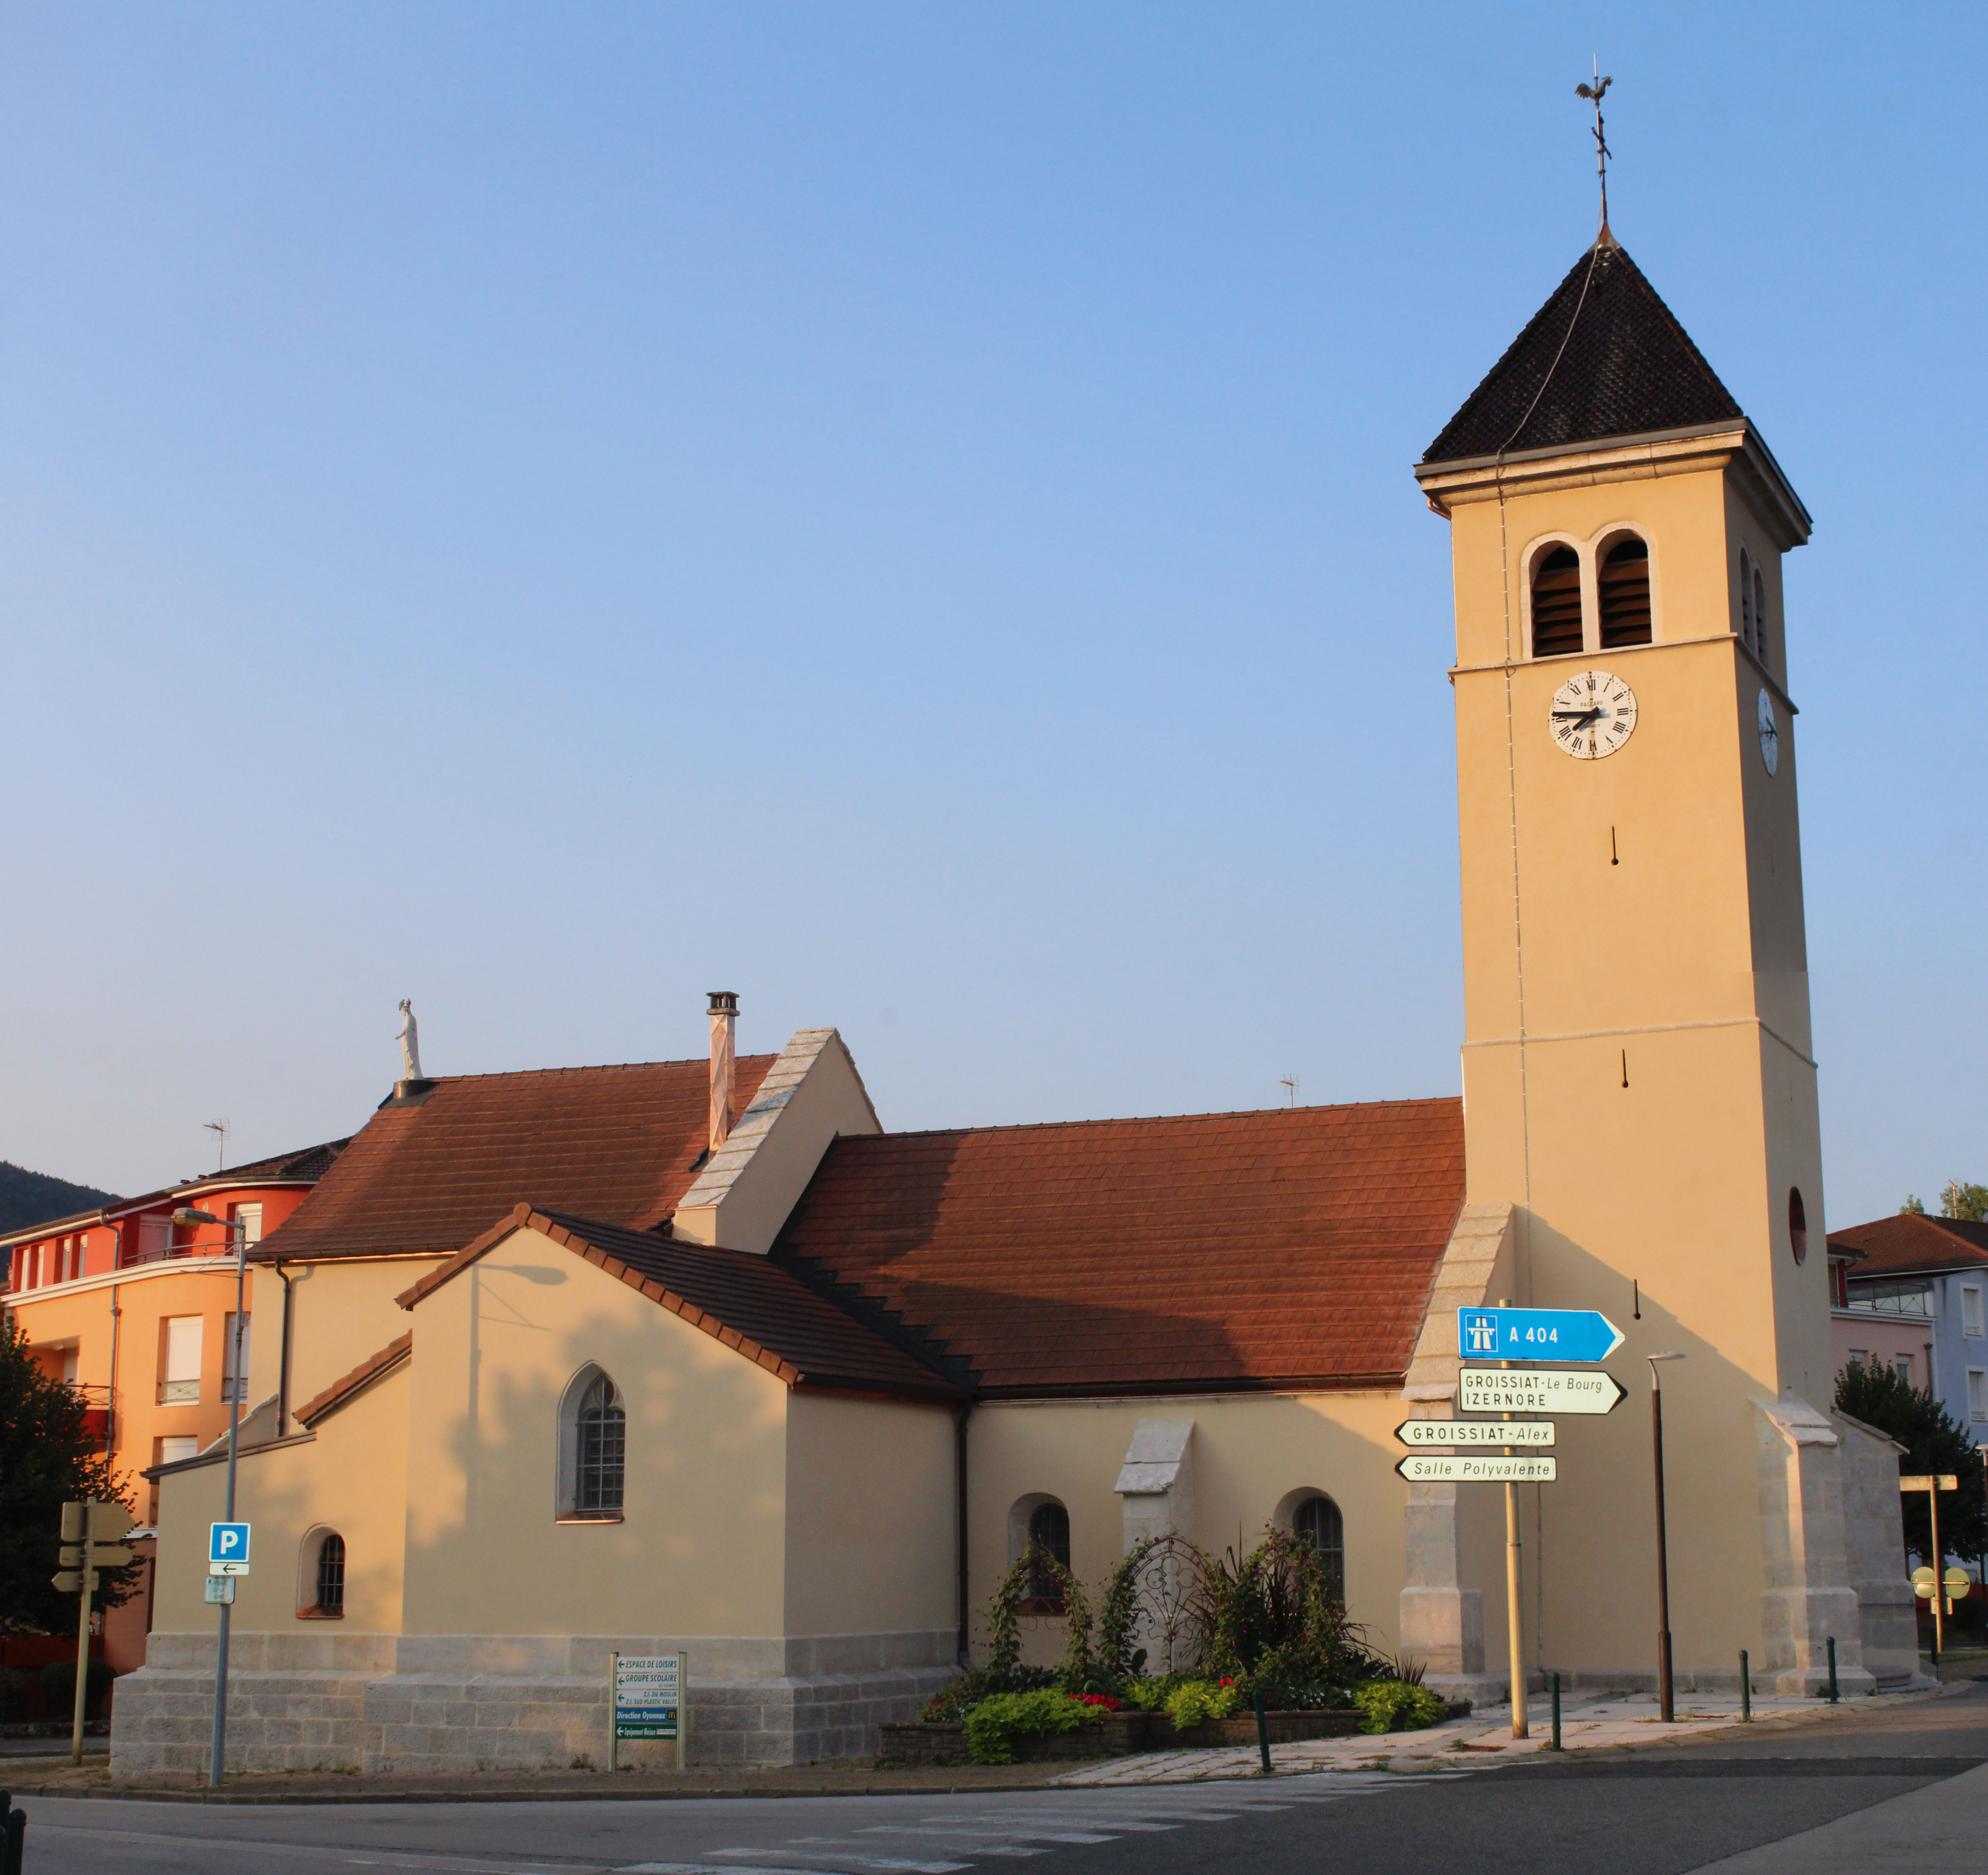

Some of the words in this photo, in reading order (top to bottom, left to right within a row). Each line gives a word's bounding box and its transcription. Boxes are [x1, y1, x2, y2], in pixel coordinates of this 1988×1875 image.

[1510, 1327, 1518, 1342] A
[1525, 1327, 1558, 1343] 404
[1567, 1378, 1603, 1393] Bourg
[1466, 1393, 1546, 1406] IZERNORE
[1414, 1462, 1452, 1475] Salle
[1463, 1462, 1549, 1477] Polyvalente
[220, 1531, 238, 1554] P
[642, 1711, 665, 1721] Oyonnax
